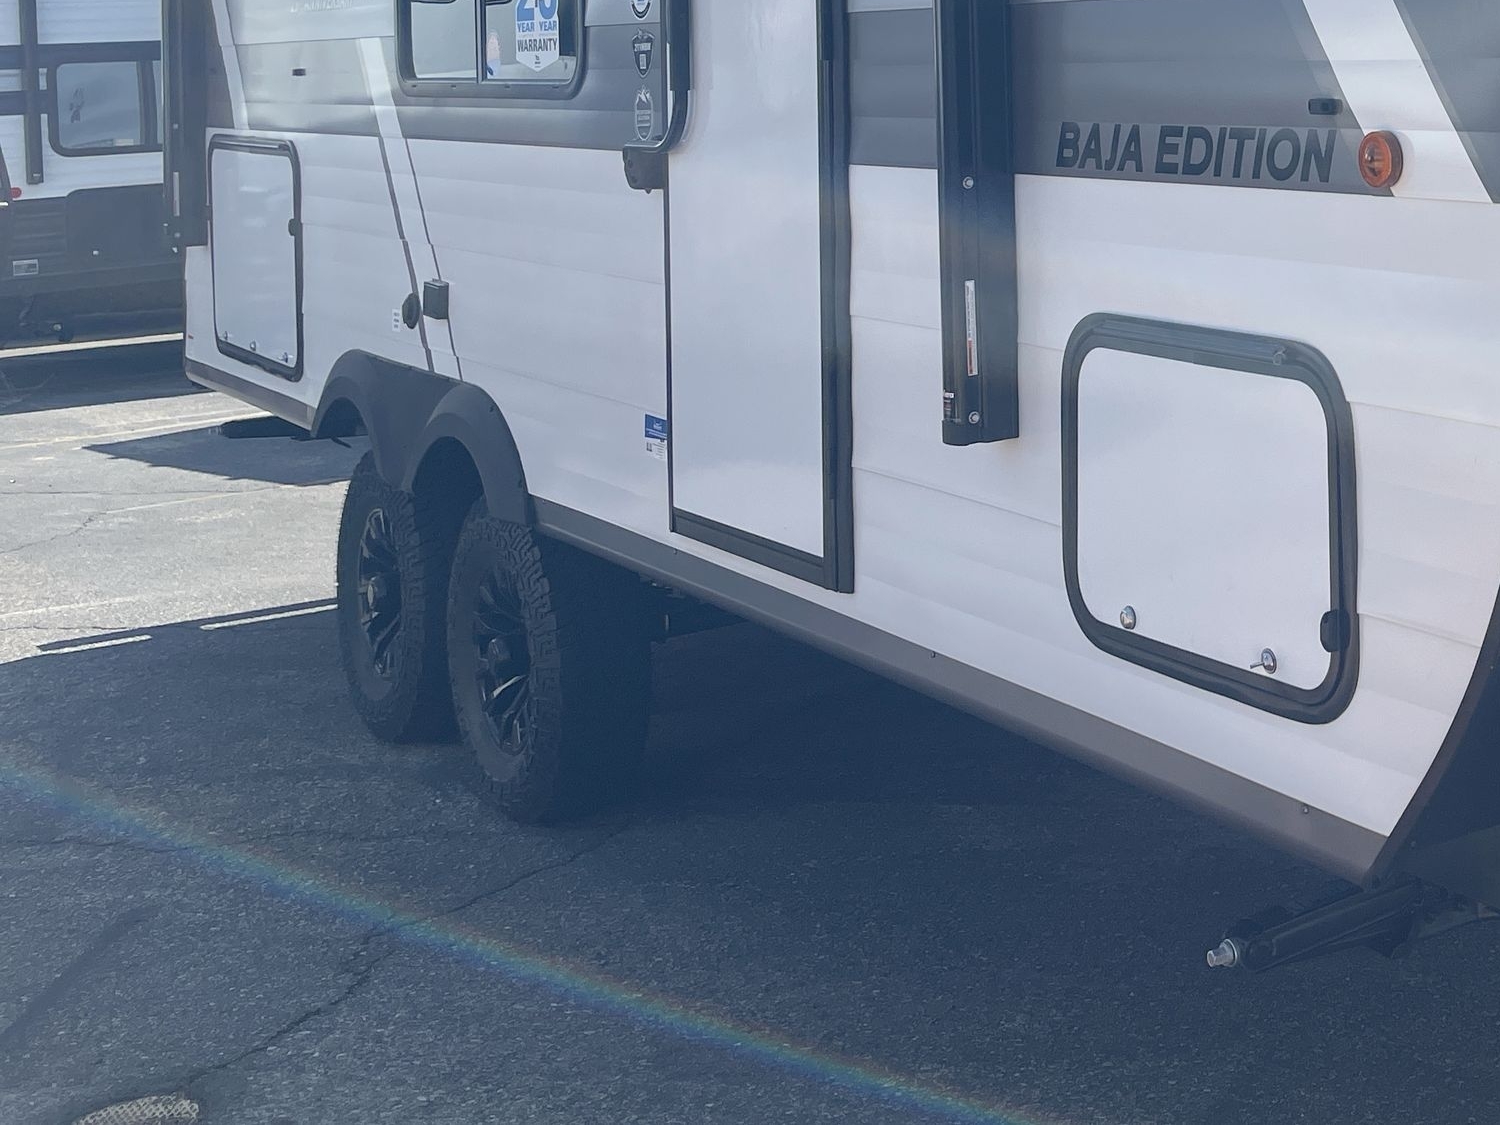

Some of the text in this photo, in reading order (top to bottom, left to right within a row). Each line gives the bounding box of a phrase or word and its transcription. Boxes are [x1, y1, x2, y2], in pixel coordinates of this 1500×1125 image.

[517, 20, 557, 32] YEAR YEAR
[517, 38, 558, 52] WARRANTY
[1055, 121, 1337, 183] BAJA EDITION
